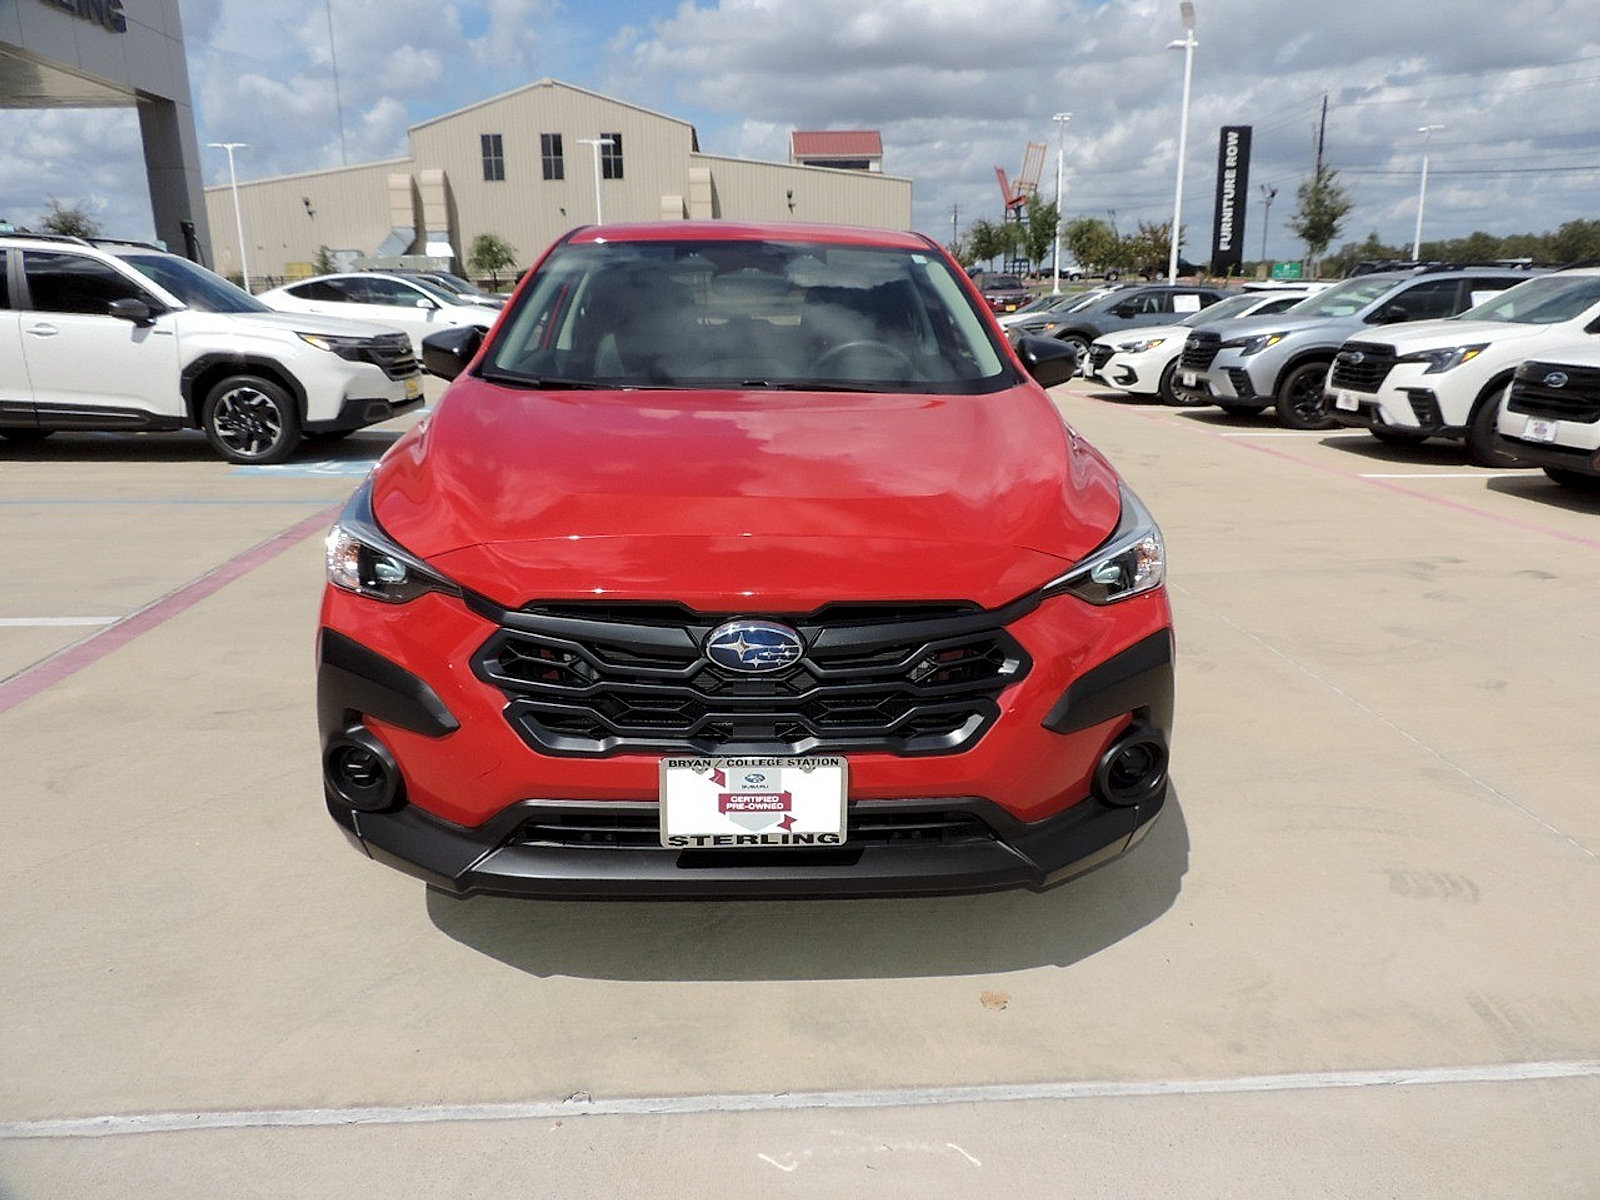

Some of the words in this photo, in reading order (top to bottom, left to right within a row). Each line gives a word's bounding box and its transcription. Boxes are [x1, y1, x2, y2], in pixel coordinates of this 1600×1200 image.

[1225, 131, 1239, 167] ROW
[1219, 169, 1237, 251] FURNITURE
[668, 759, 712, 767] BRYAN
[726, 759, 783, 767] COLLEGE
[787, 758, 839, 767] STATION
[668, 833, 841, 847] STERLING
